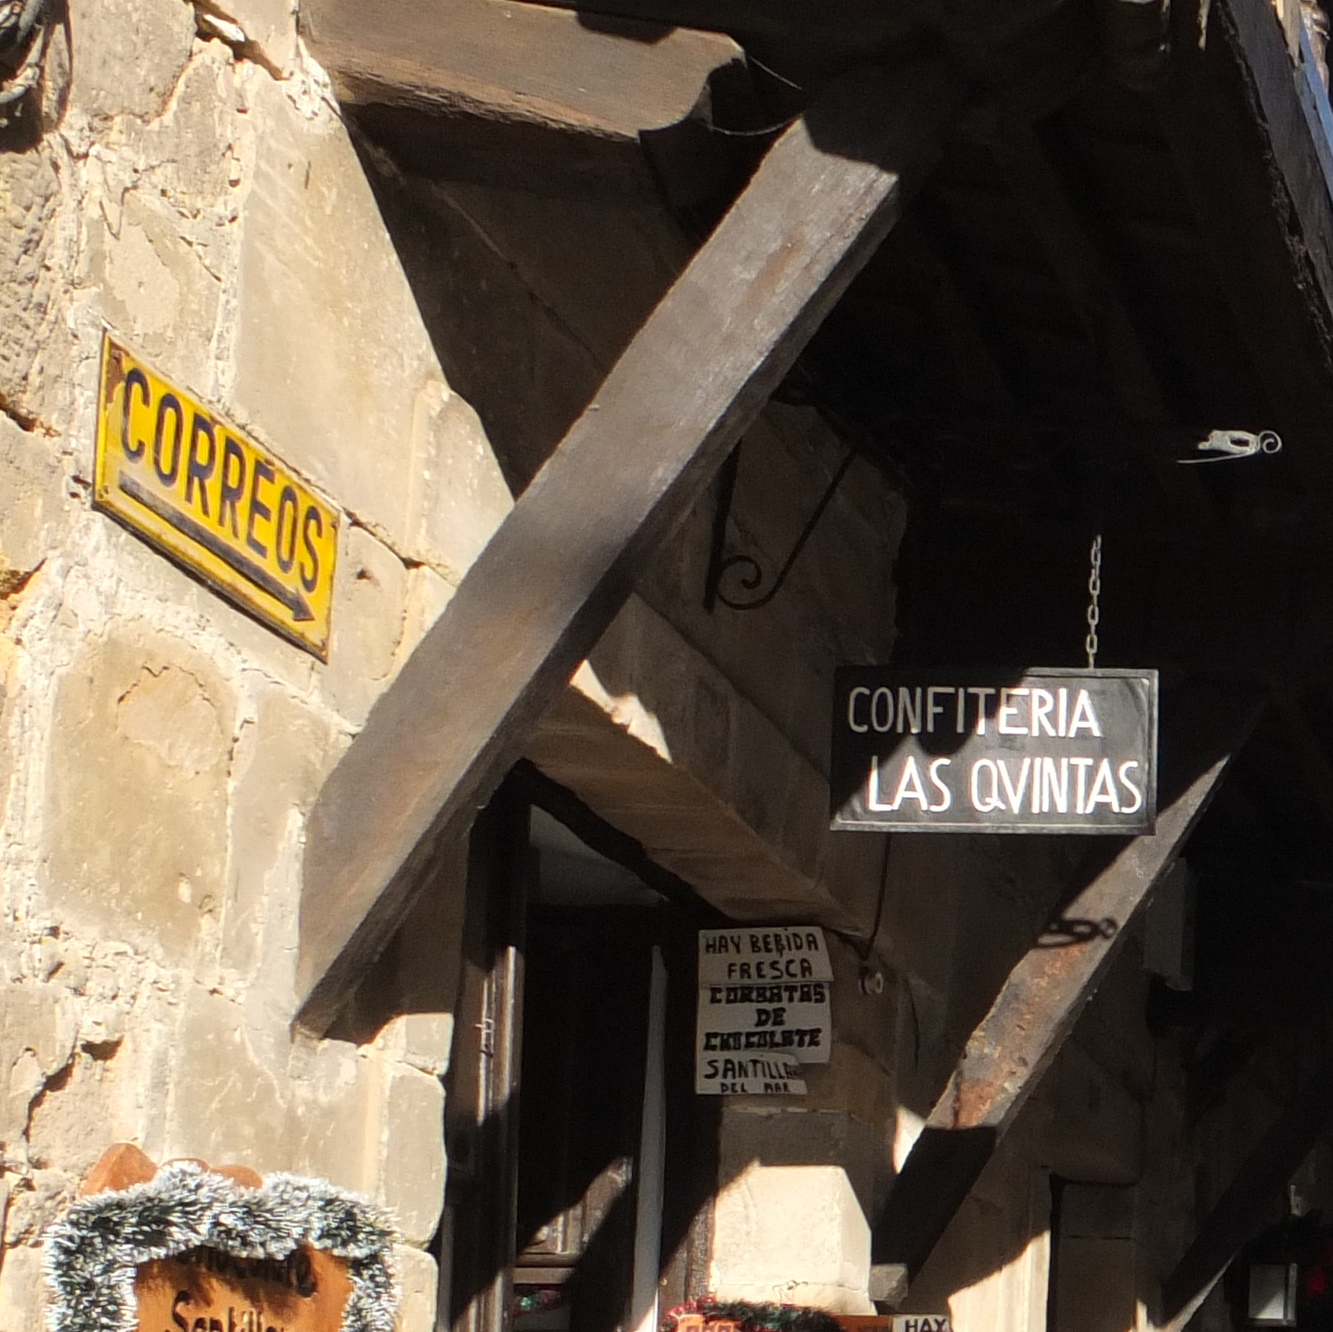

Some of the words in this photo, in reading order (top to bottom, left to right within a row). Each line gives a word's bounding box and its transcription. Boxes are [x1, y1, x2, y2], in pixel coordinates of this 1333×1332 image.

[121, 366, 325, 594] CORREOS
[847, 686, 1104, 738] CONFITERIA
[867, 755, 952, 813] LAS
[970, 757, 1142, 815] QVINTAS
[705, 935, 741, 954] HAY
[749, 932, 819, 957] BEBIDA
[727, 958, 813, 979] FRESCA
[710, 983, 826, 1004] CORBATAS
[755, 1007, 786, 1027] DE
[703, 1028, 823, 1051] CHOCOLATE
[720, 1082, 747, 1094] DEL
[764, 1082, 791, 1093] MAR
